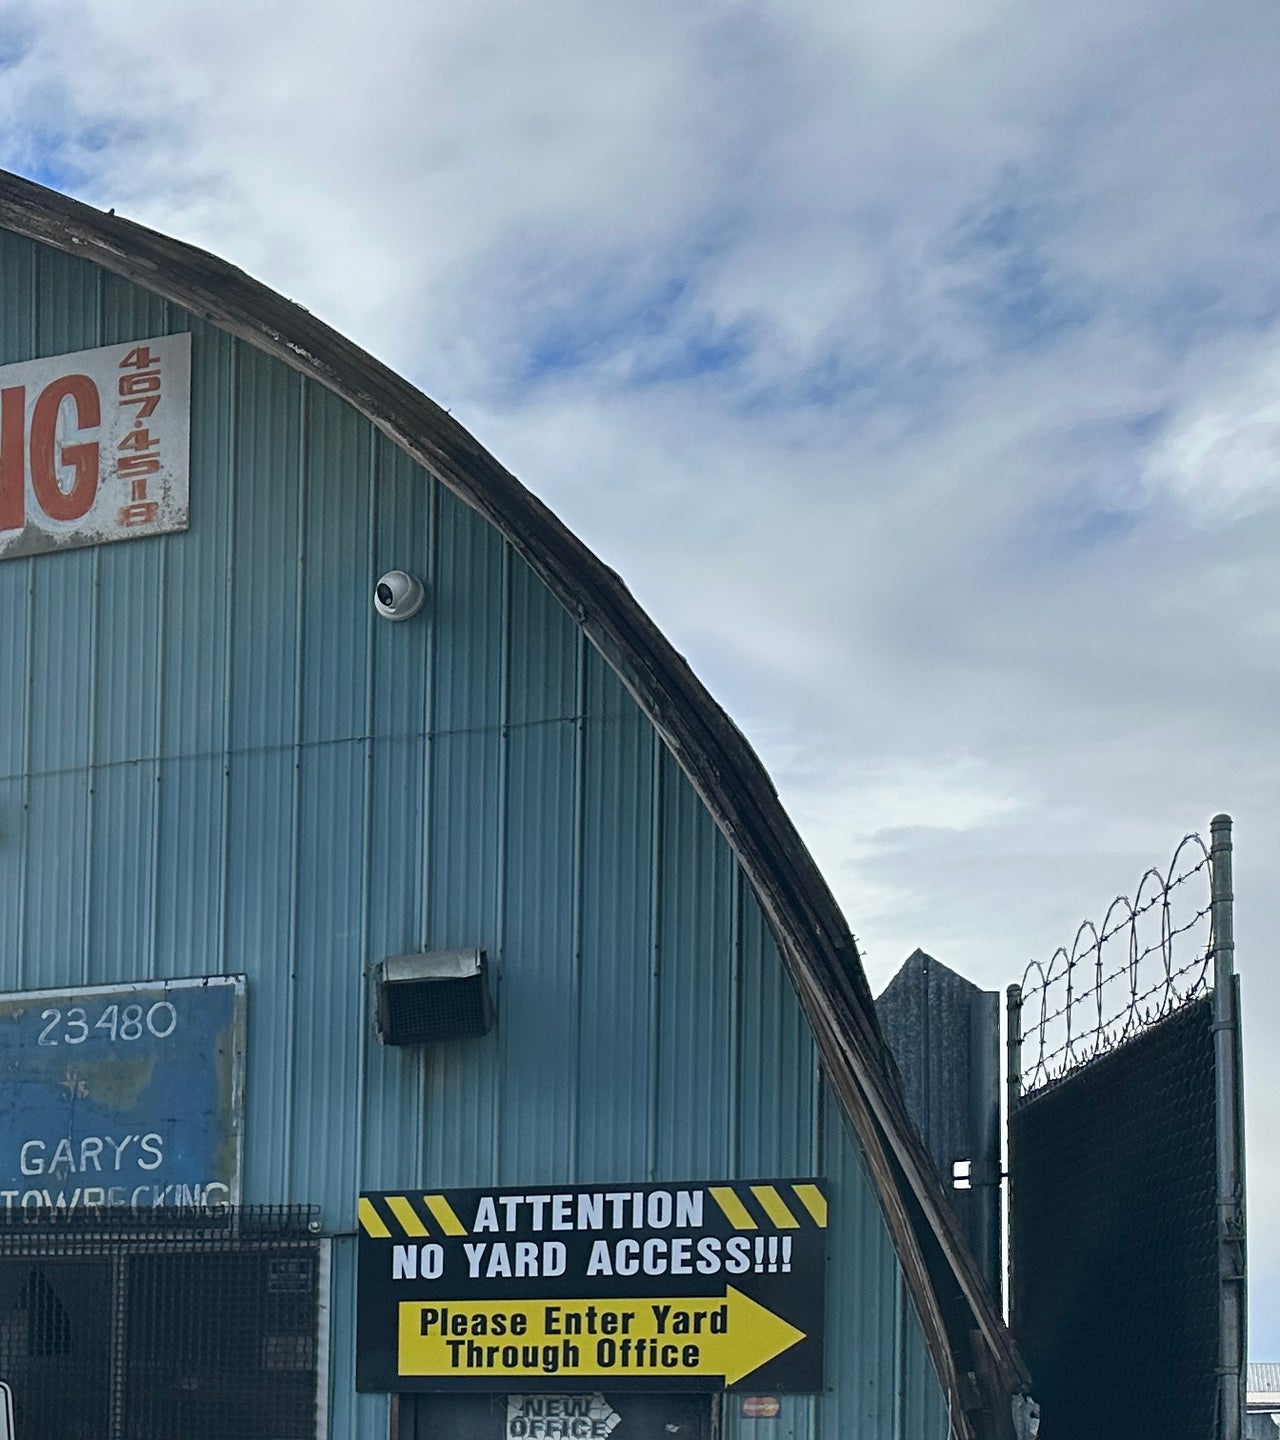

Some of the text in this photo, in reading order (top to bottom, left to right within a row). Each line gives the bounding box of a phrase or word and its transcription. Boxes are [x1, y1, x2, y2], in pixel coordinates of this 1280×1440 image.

[37, 1001, 178, 1046] 23480
[20, 1132, 164, 1176] GARY'S
[473, 1190, 704, 1233] ATTENTION
[392, 1236, 792, 1280] NO YARD ACCESS!!!
[420, 1303, 728, 1337] Please Enter Yard
[446, 1338, 700, 1373] Through Office
[509, 1415, 607, 1439] OFFICE
[523, 1398, 591, 1418] NEW
